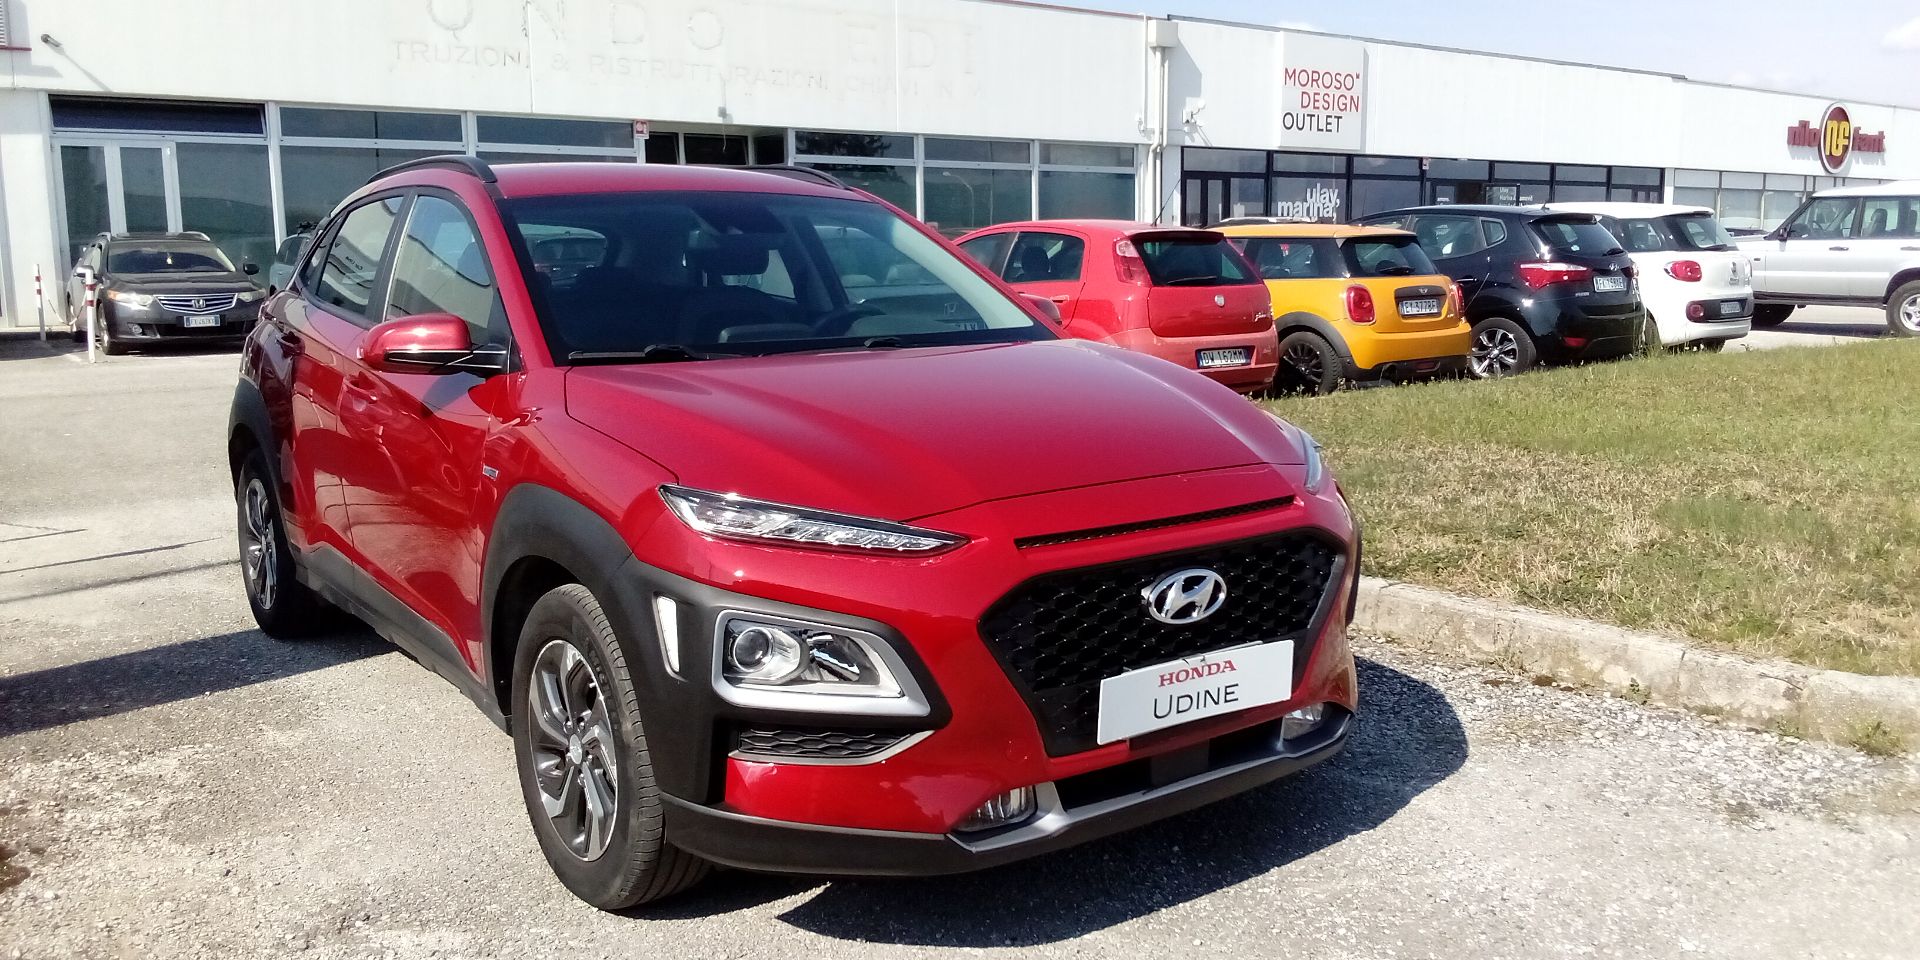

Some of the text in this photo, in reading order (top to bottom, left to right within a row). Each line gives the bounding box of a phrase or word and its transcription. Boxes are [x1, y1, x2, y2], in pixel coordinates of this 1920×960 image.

[1284, 68, 1355, 91] MOROSO
[1301, 91, 1360, 112] DESIGN
[1282, 112, 1342, 133] OUTLET
[1158, 659, 1236, 687] HONDA
[1153, 683, 1239, 719] UDINE
